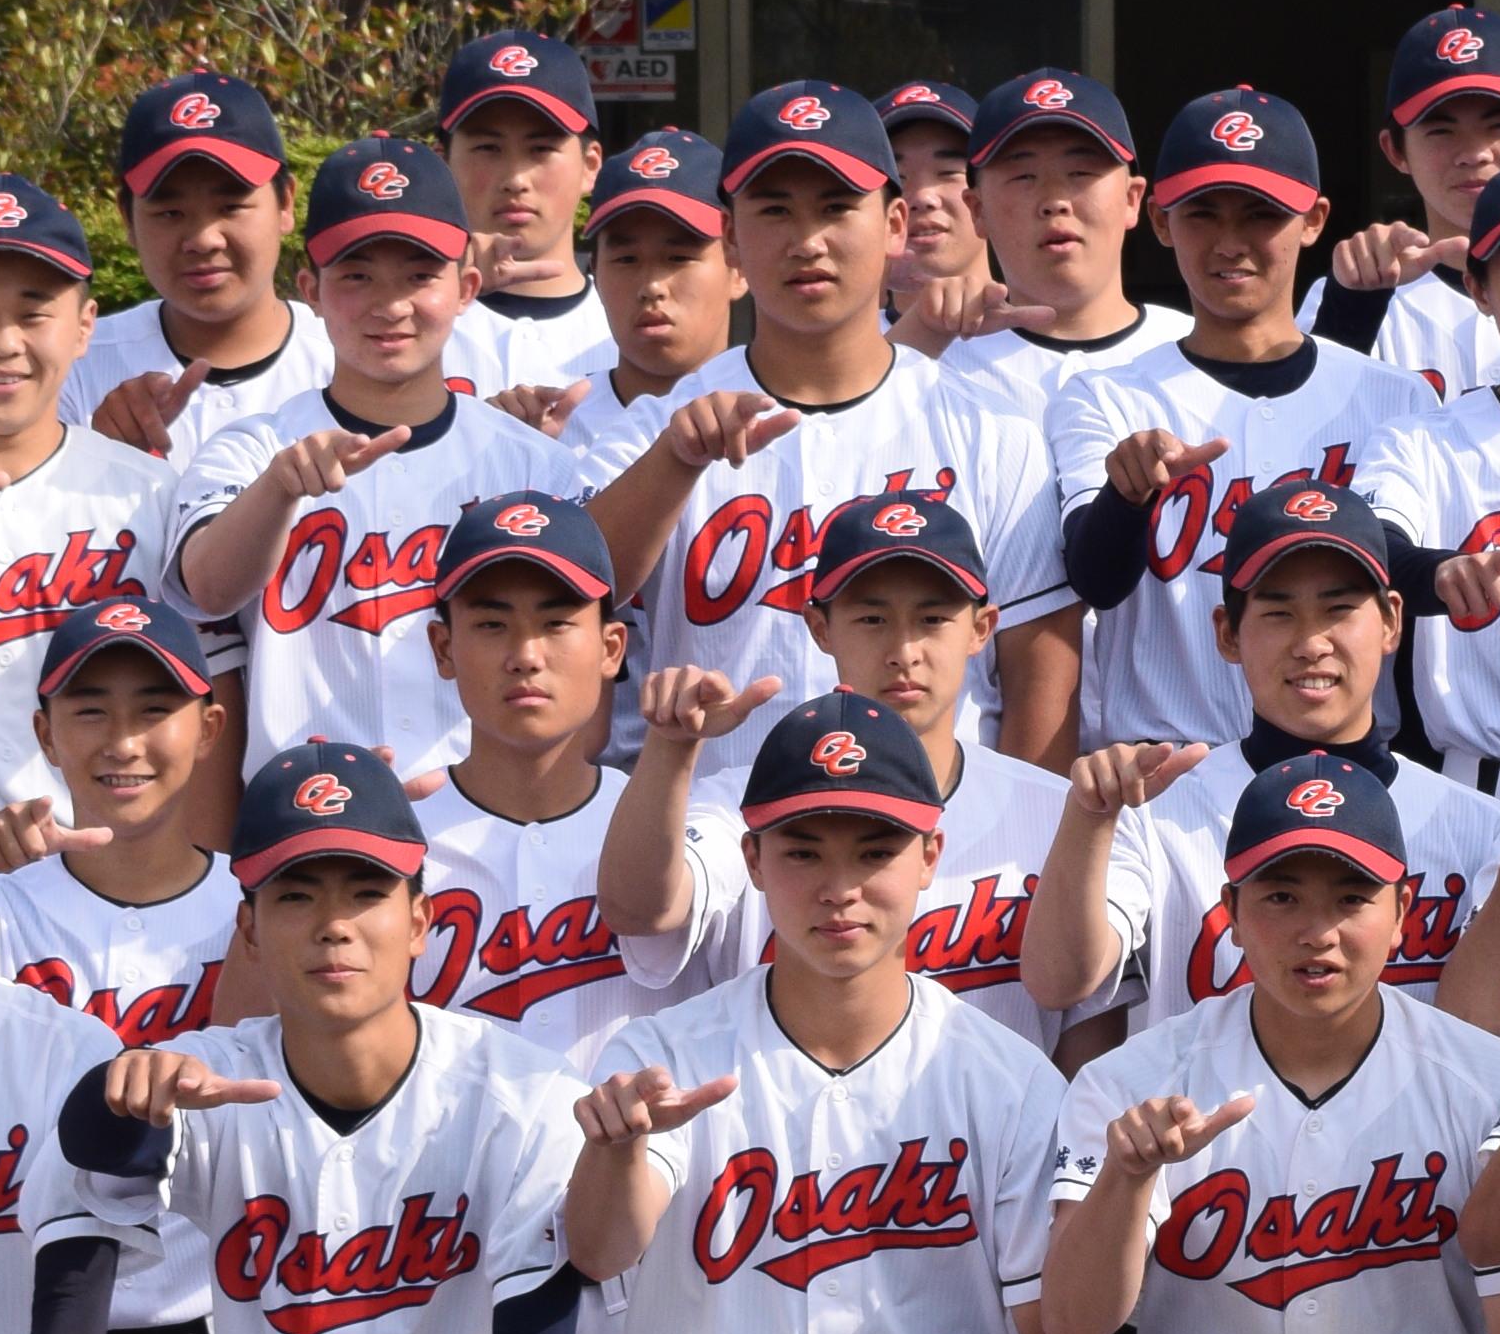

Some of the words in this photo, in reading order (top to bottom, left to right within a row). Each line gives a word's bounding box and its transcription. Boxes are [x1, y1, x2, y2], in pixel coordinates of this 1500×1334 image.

[615, 59, 669, 78] AED
[216, 1192, 480, 1302] Osaki
[694, 1137, 978, 1284] Osaki
[1155, 1151, 1456, 1280] Osaki
